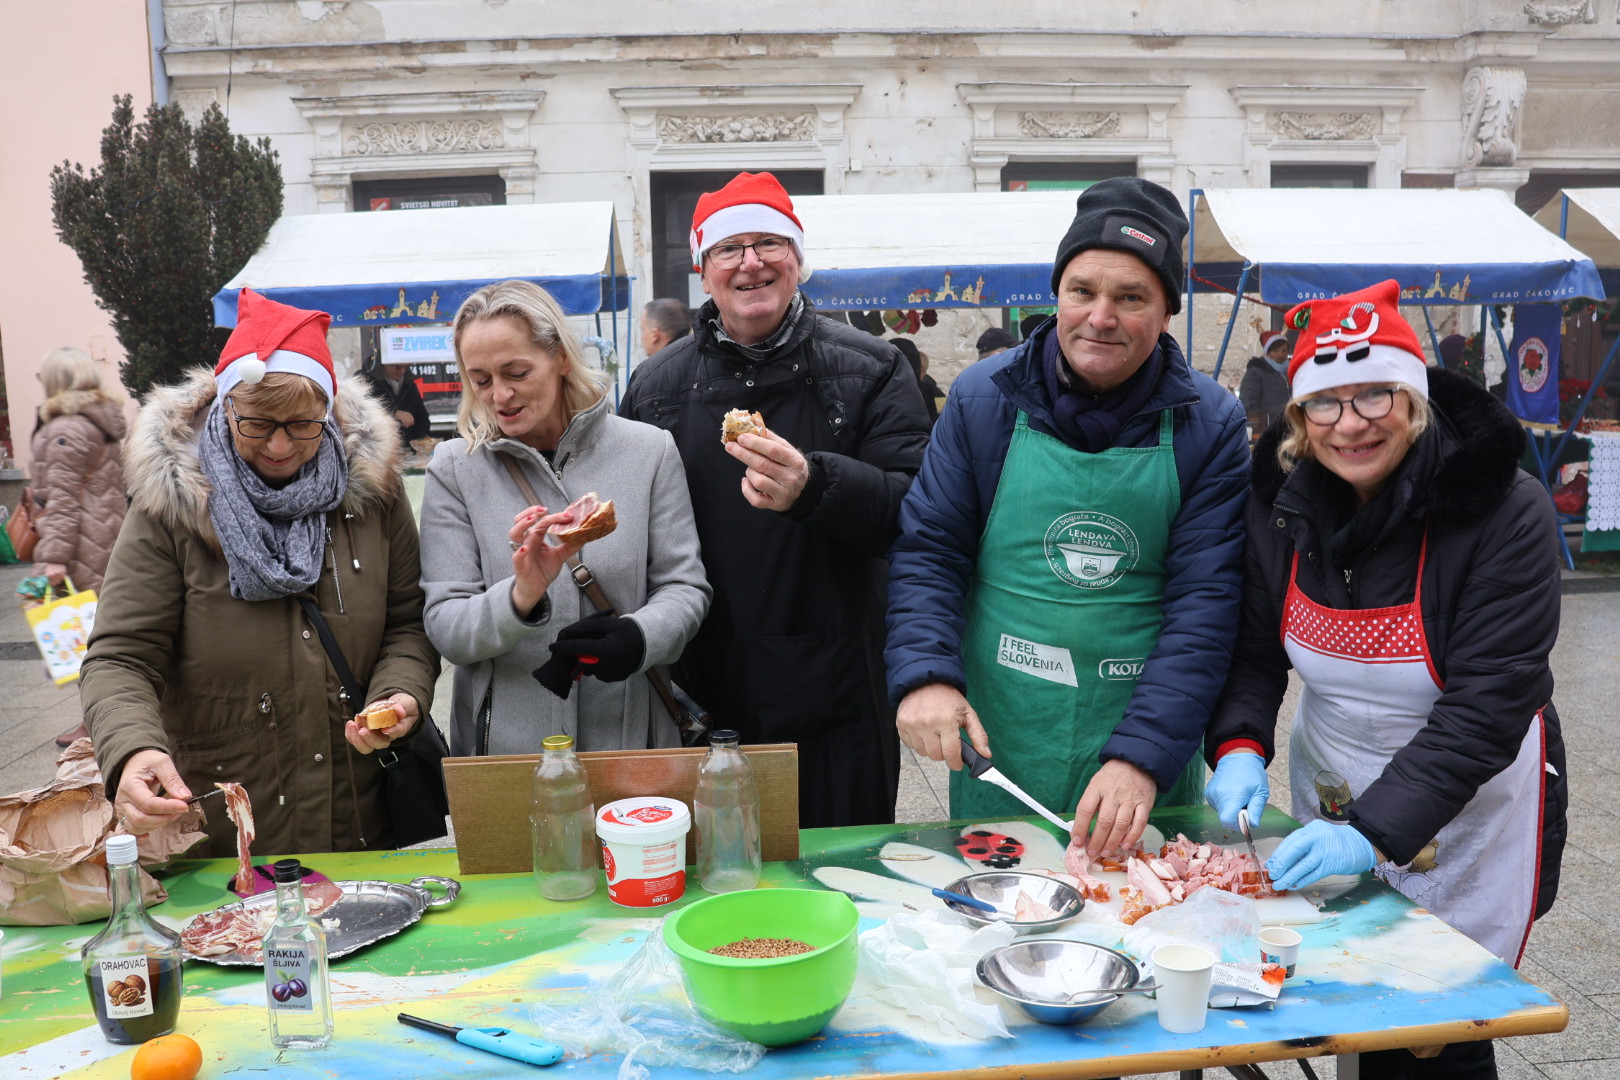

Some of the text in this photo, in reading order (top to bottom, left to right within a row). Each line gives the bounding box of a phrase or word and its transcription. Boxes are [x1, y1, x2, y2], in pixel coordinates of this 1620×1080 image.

[431, 200, 458, 208] NOVITET
[1129, 229, 1154, 244] Castrol
[1492, 286, 1575, 299] GRAD ČAKOVEC
[831, 297, 887, 305] ČAKOVEC
[403, 335, 448, 351] ZVIREK
[419, 365, 437, 375] 1492
[1068, 528, 1117, 542] LENDAVA
[1071, 537, 1113, 548] LENDVA
[1002, 637, 1038, 656] I FEEL
[1001, 650, 1064, 672] SLOVENIA
[268, 950, 305, 958] RAKIJA
[101, 958, 146, 970] ORAHOVAC
[272, 959, 301, 967] ŠLJIVA
